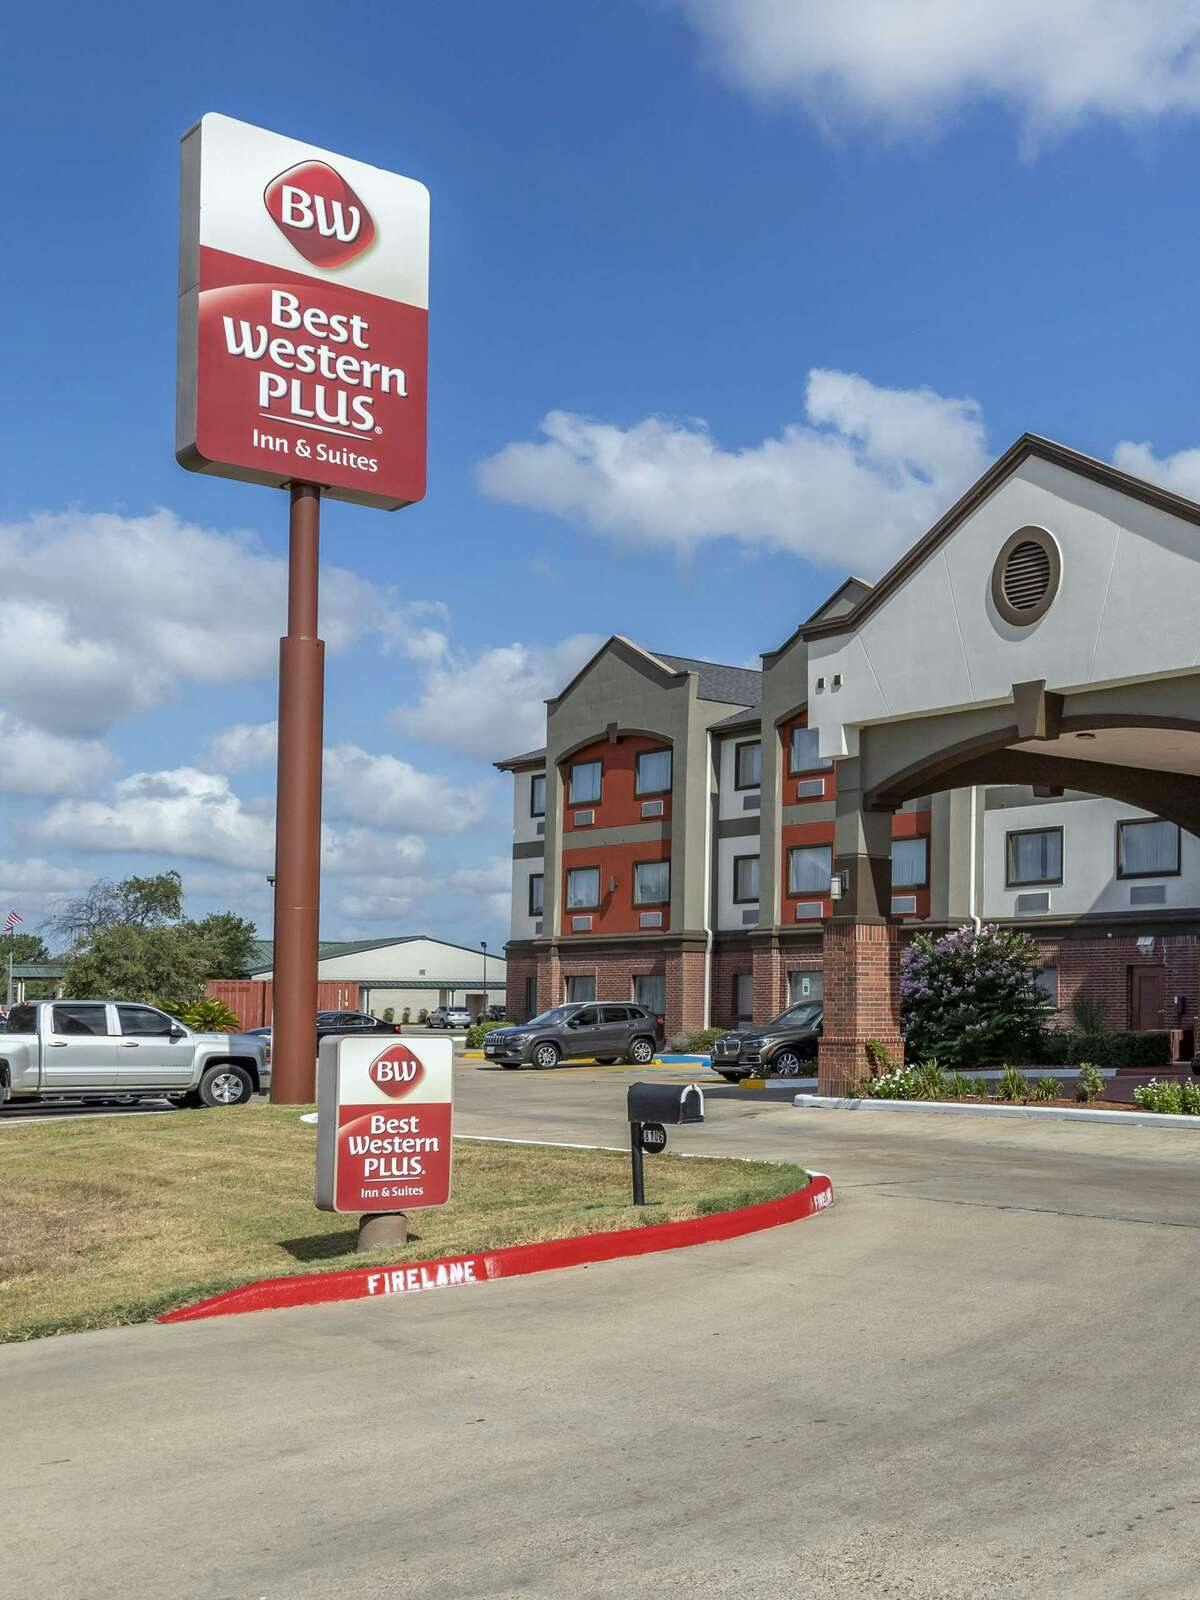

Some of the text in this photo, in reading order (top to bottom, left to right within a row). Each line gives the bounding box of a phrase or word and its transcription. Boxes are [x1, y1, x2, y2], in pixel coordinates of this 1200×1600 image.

[280, 184, 360, 242] BW
[271, 289, 370, 349] Best
[222, 316, 409, 397] Western
[252, 428, 378, 473] Inn & Suites
[376, 1060, 417, 1082] BW
[370, 1115, 420, 1135] Best
[348, 1135, 440, 1155] Western
[361, 1185, 424, 1198] Inn & Suites
